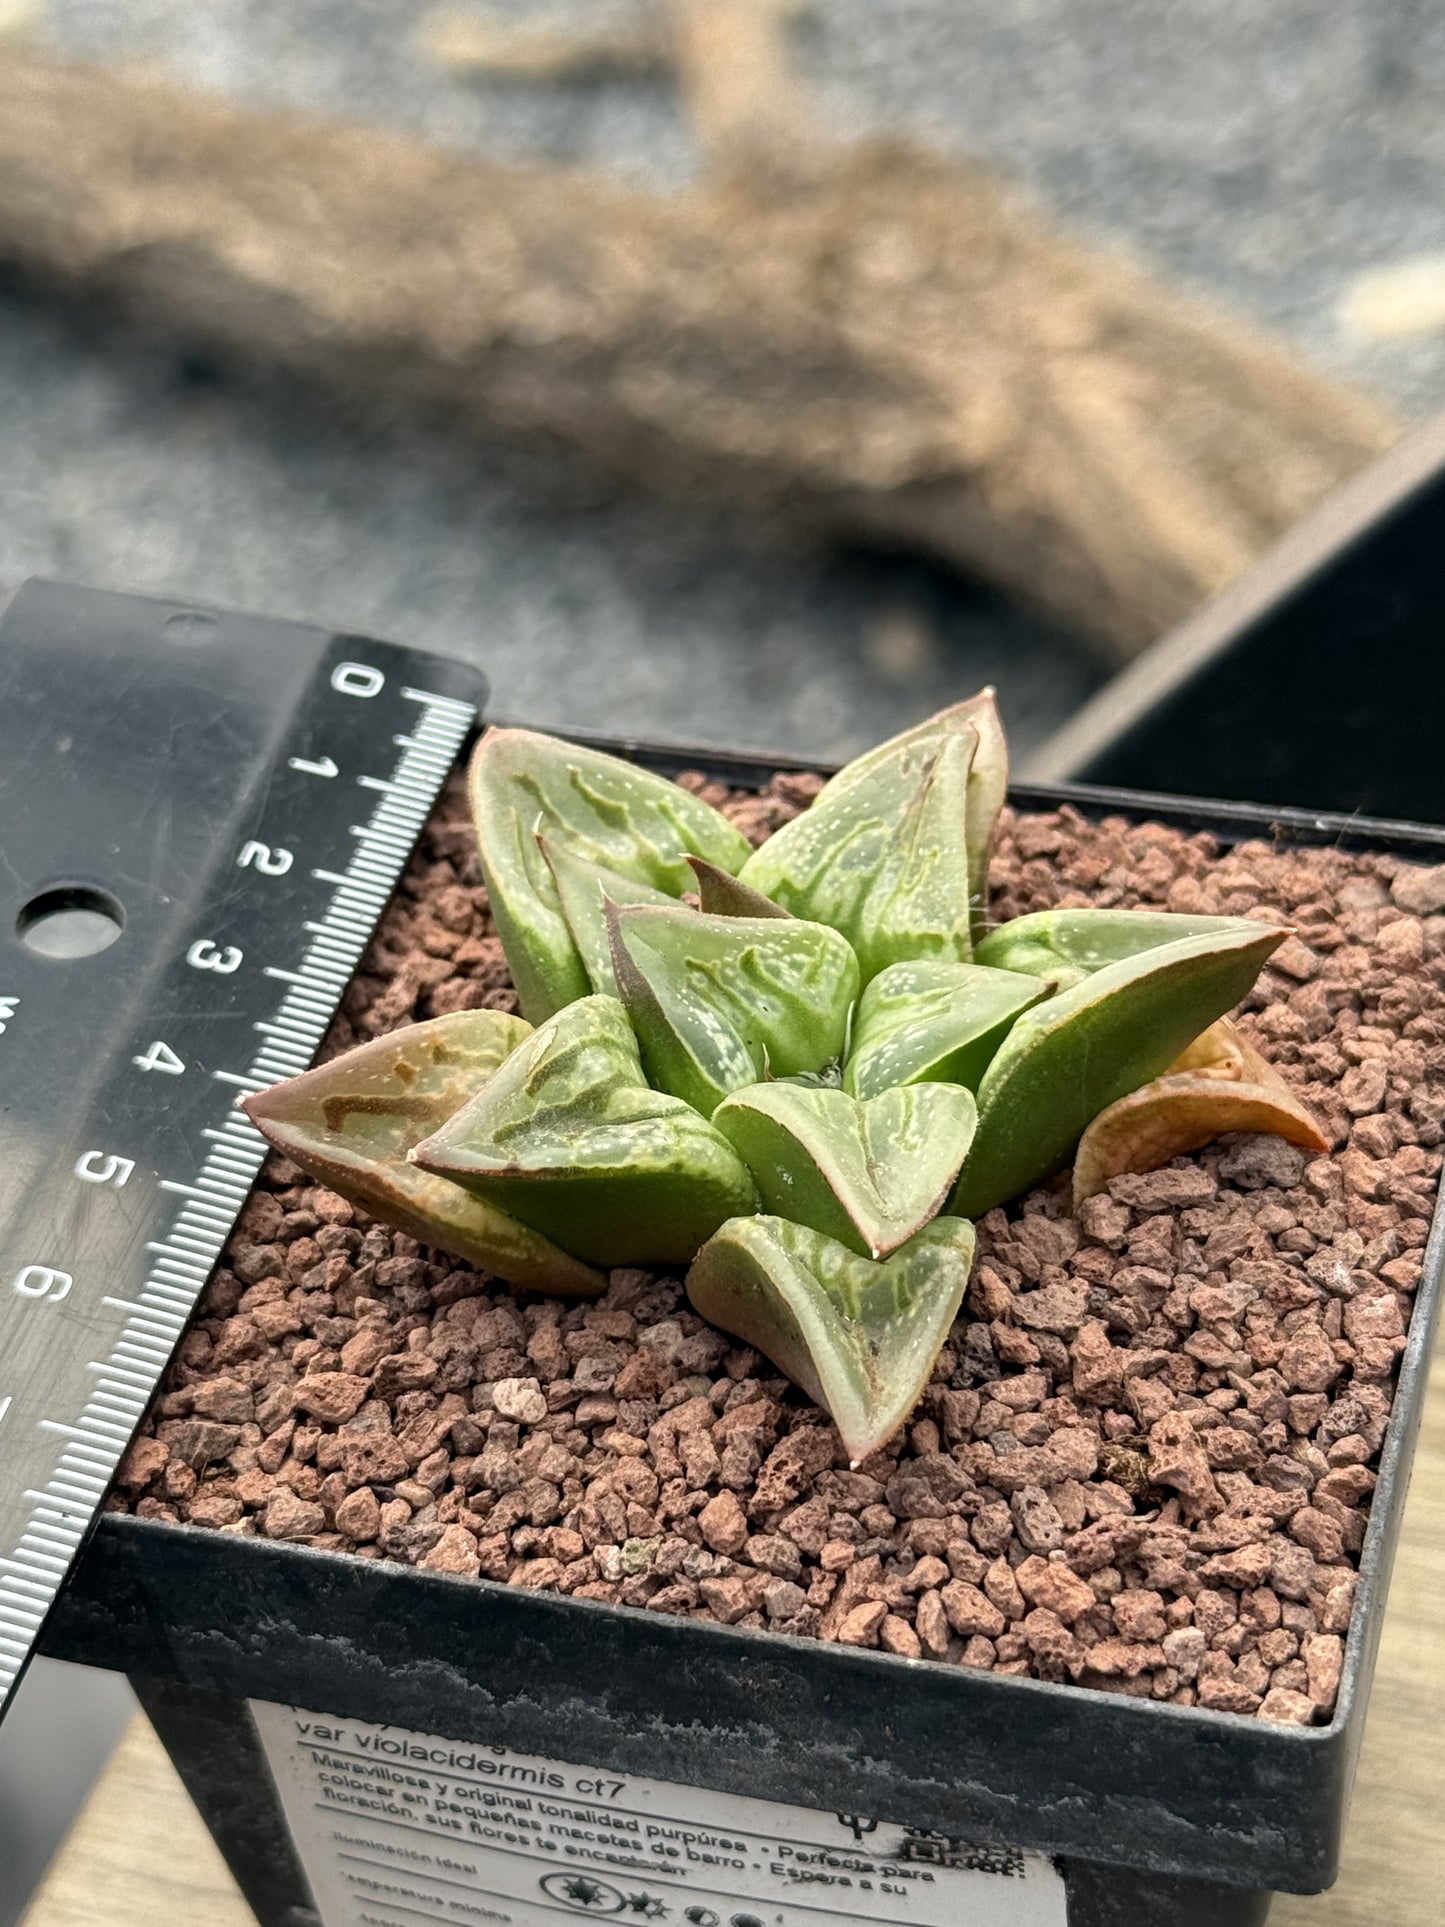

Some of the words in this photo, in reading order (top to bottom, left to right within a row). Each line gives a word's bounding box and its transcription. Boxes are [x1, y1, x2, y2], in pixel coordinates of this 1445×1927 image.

[329, 661, 385, 699] 0
[288, 756, 339, 780] 1
[236, 840, 294, 878] 2
[186, 939, 244, 976] 3
[131, 1040, 186, 1077] 4
[75, 1150, 136, 1190] 5
[14, 1264, 74, 1305] 6
[295, 1720, 346, 1742] var
[354, 1732, 565, 1789] violacidermis
[576, 1777, 628, 1799] ct7
[312, 1751, 431, 1790] Maravillosa
[435, 1782, 448, 1796] y
[455, 1786, 532, 1812] original
[538, 1801, 640, 1832] tonalidad
[646, 1824, 748, 1853] purpúrea
[778, 1845, 876, 1873] Perfecta
[881, 1865, 935, 1882] para
[318, 1772, 395, 1797] colocar
[402, 1791, 428, 1805] en
[434, 1798, 542, 1832] pequeñas
[549, 1823, 643, 1851] macetas
[650, 1841, 679, 1857] de
[686, 1846, 746, 1869] barro
[770, 1861, 852, 1887] Espera
[859, 1879, 873, 1890] a
[880, 1882, 908, 1896] su
[425, 1813, 462, 1830] sus
[469, 1821, 530, 1846] flores
[535, 1836, 557, 1851] te
[436, 1856, 478, 1875] ideal
